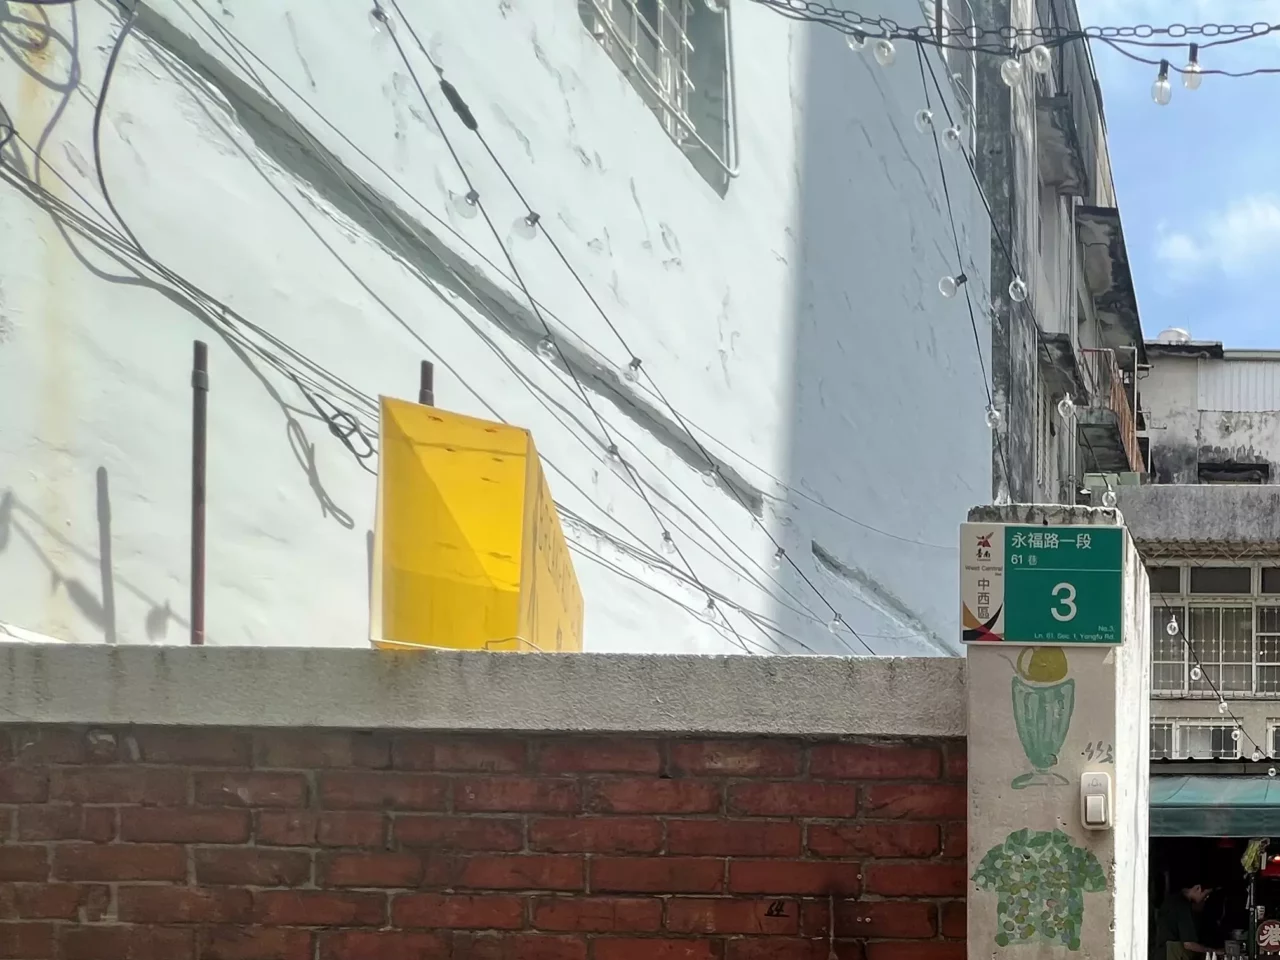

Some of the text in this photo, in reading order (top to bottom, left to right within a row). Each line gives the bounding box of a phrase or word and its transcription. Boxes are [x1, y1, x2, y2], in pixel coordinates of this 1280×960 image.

[1011, 532, 1091, 549] 永福路一段
[1011, 554, 1023, 565] 61
[977, 577, 990, 619] 中西區
[1050, 582, 1077, 622] 3
